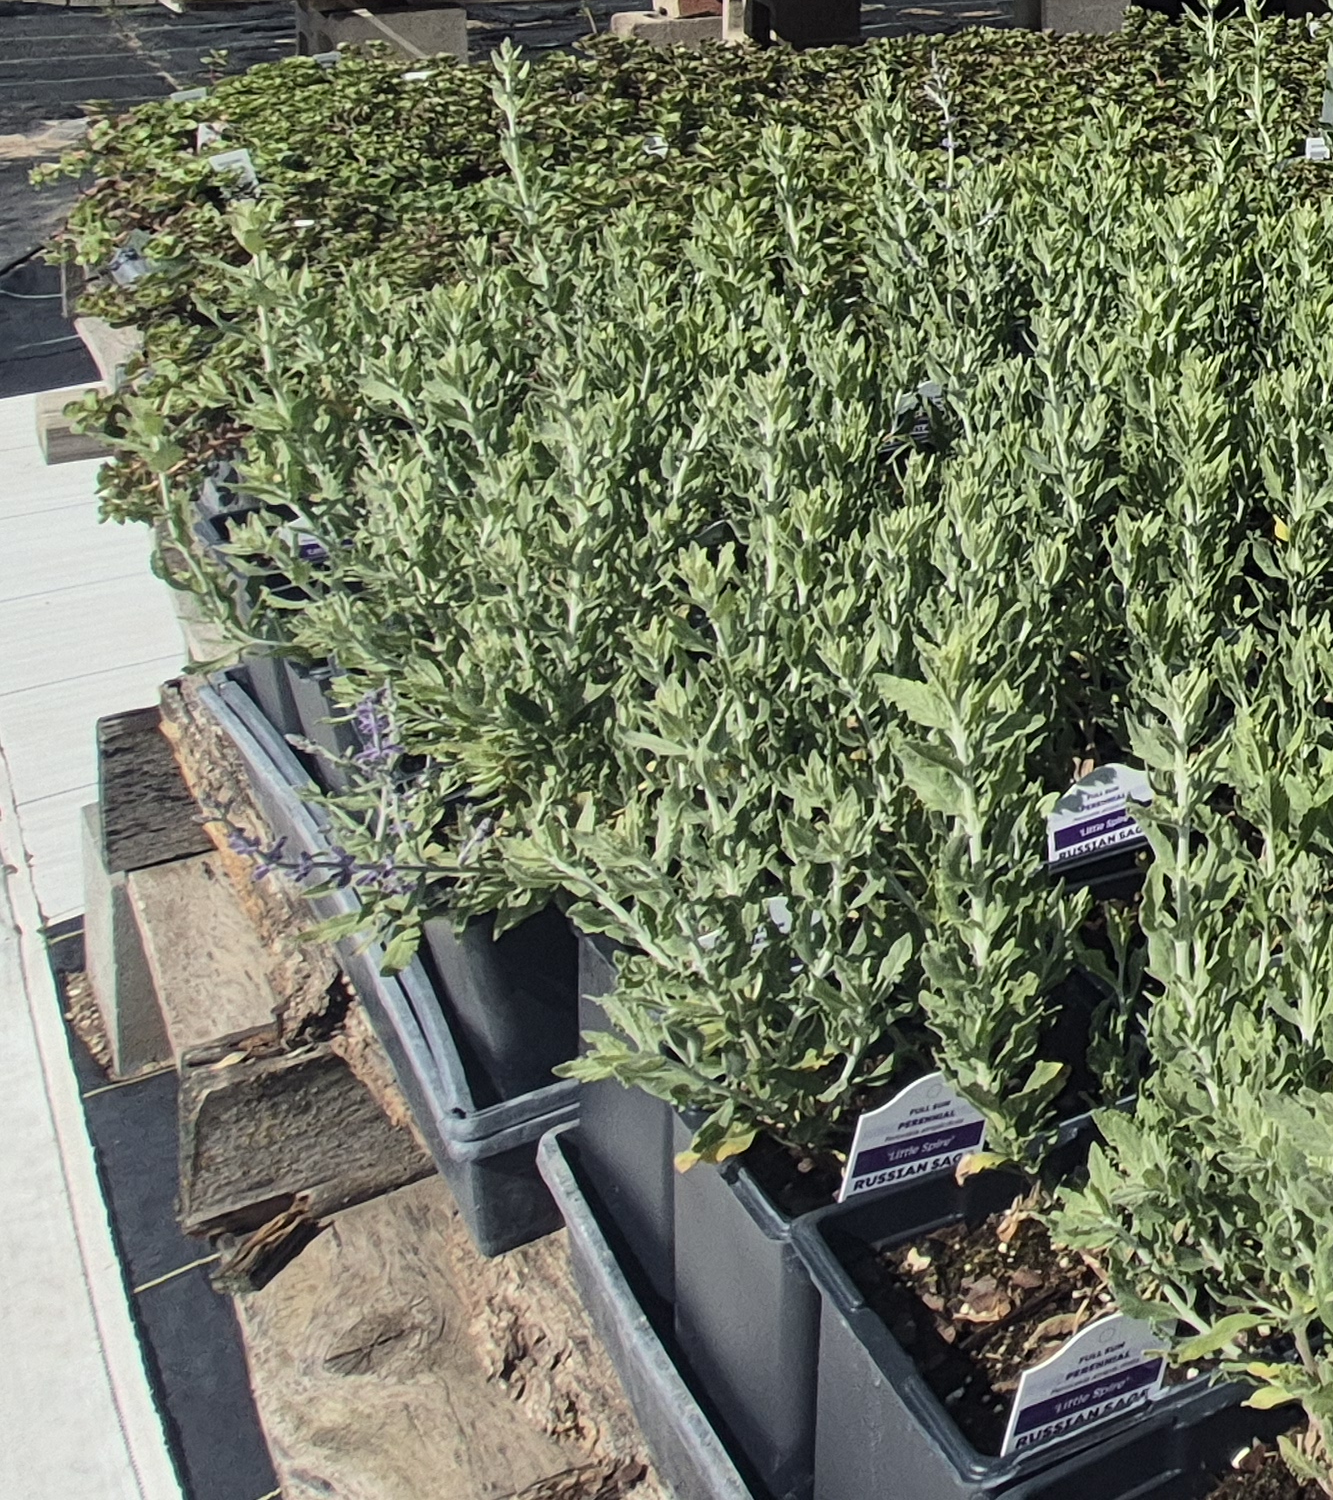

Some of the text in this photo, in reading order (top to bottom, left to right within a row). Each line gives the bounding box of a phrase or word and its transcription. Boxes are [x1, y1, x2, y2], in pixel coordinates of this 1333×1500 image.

[1058, 833, 1116, 860] RUSSIAN
[897, 1110, 956, 1131] PERENNIAL
[909, 1105, 931, 1116] FULL
[853, 1161, 929, 1192] RUSSIAN
[1065, 1350, 1131, 1381] PERENNIAL
[1078, 1349, 1103, 1364] FULL
[1015, 1407, 1100, 1449] RUSSIAN
